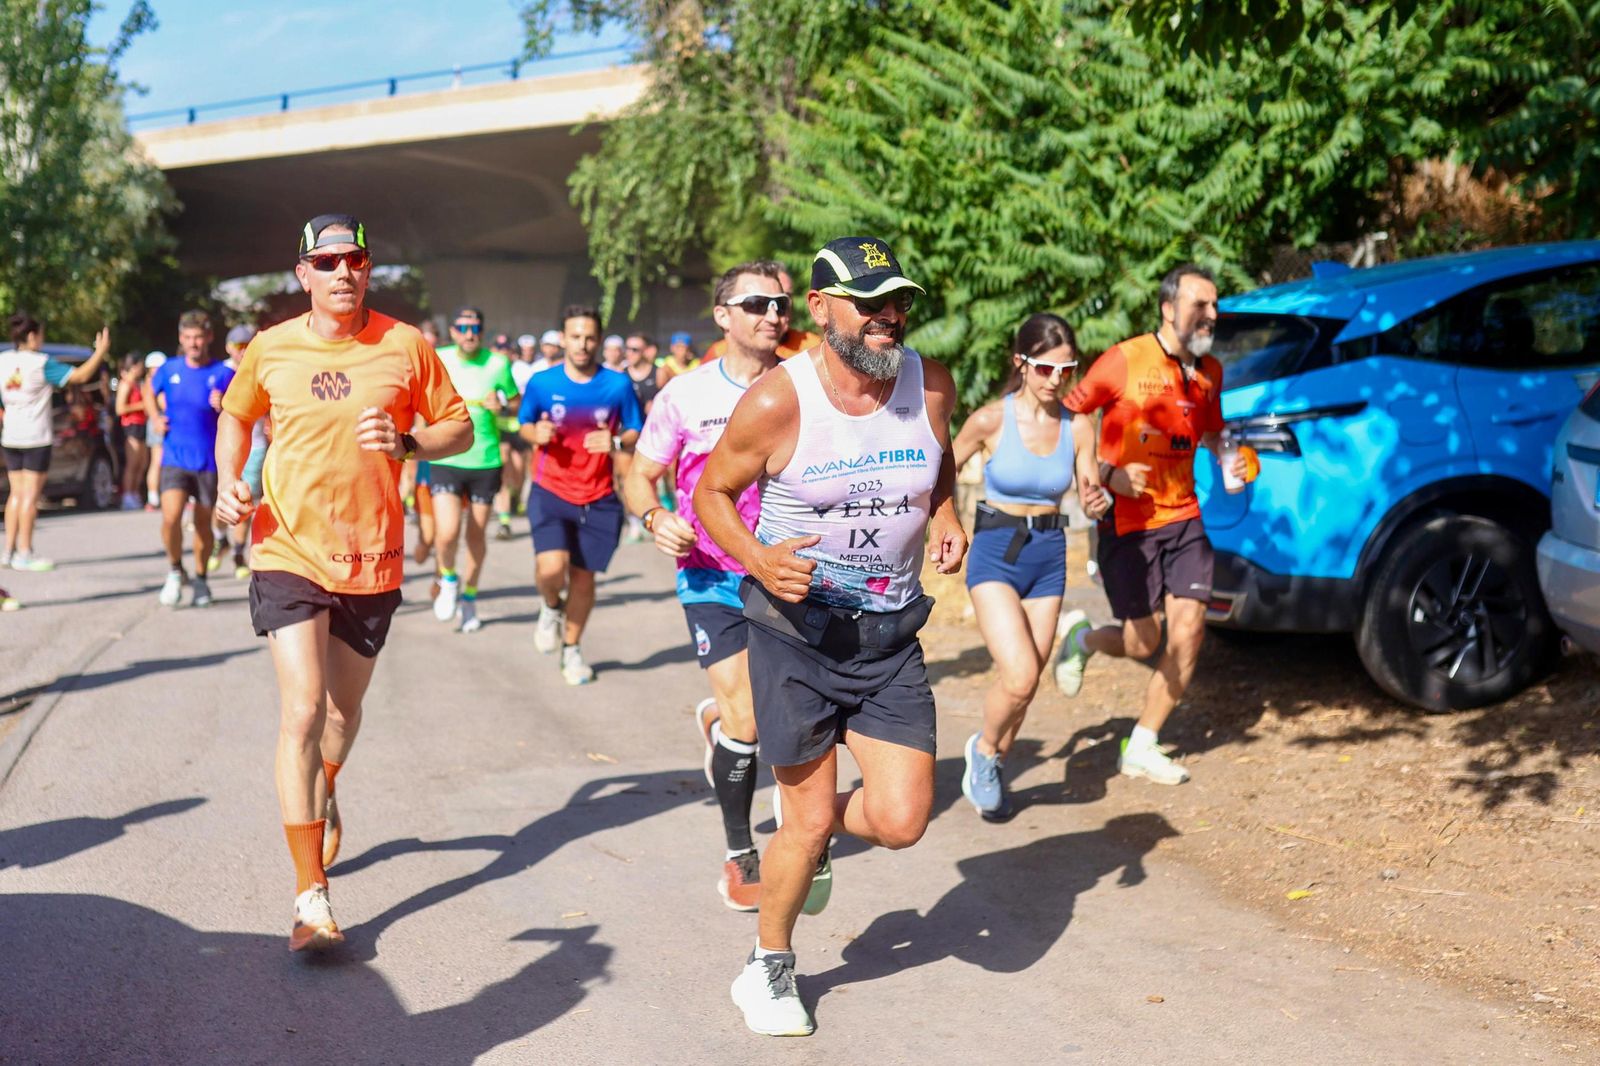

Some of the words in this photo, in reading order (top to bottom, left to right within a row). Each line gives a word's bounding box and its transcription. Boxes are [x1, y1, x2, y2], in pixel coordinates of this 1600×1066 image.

[802, 455, 877, 478] AVANZA
[879, 448, 926, 463] FIBRA
[849, 479, 883, 495] 2023
[813, 494, 911, 519] VERA
[848, 528, 881, 549] IX
[840, 554, 883, 563] MEDIA
